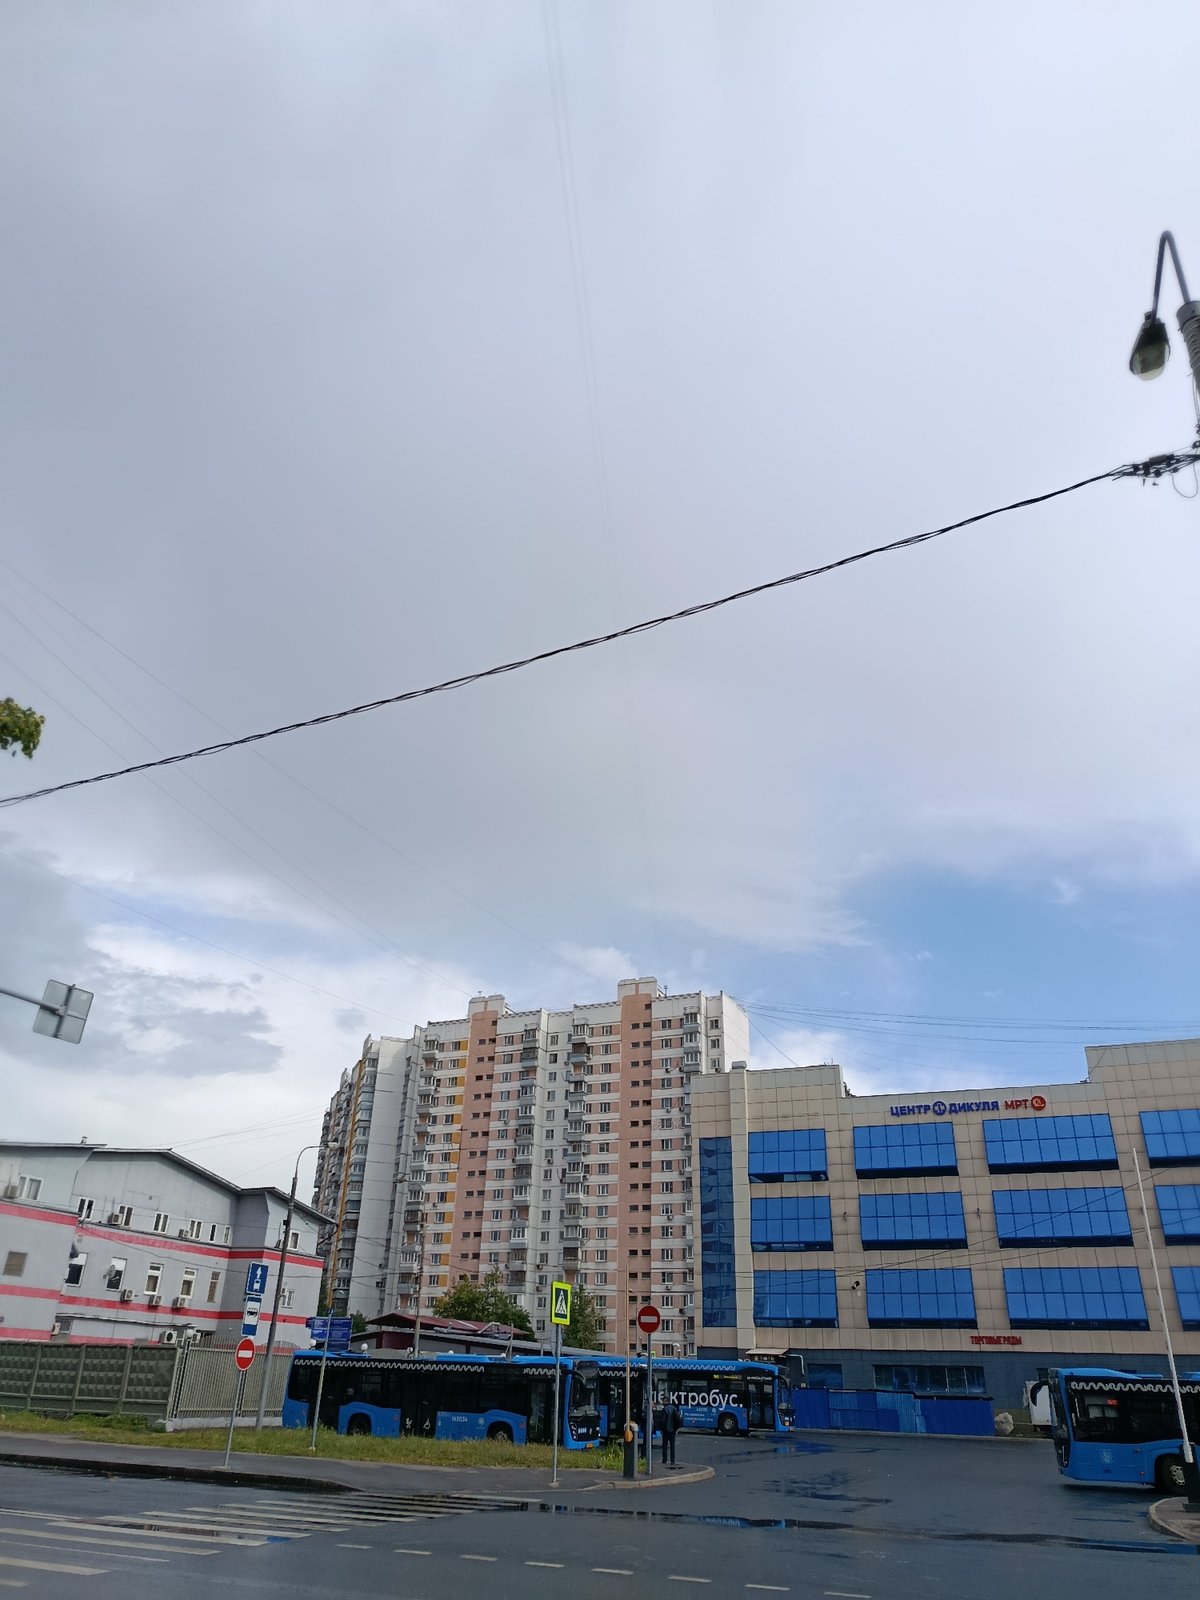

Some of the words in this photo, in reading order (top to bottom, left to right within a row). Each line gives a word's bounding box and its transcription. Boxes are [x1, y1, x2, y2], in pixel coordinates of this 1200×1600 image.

[890, 1104, 931, 1117] ЦЕНТР
[949, 1101, 1000, 1115] ДИКУЛЯ
[1004, 1099, 1029, 1110] МРТ
